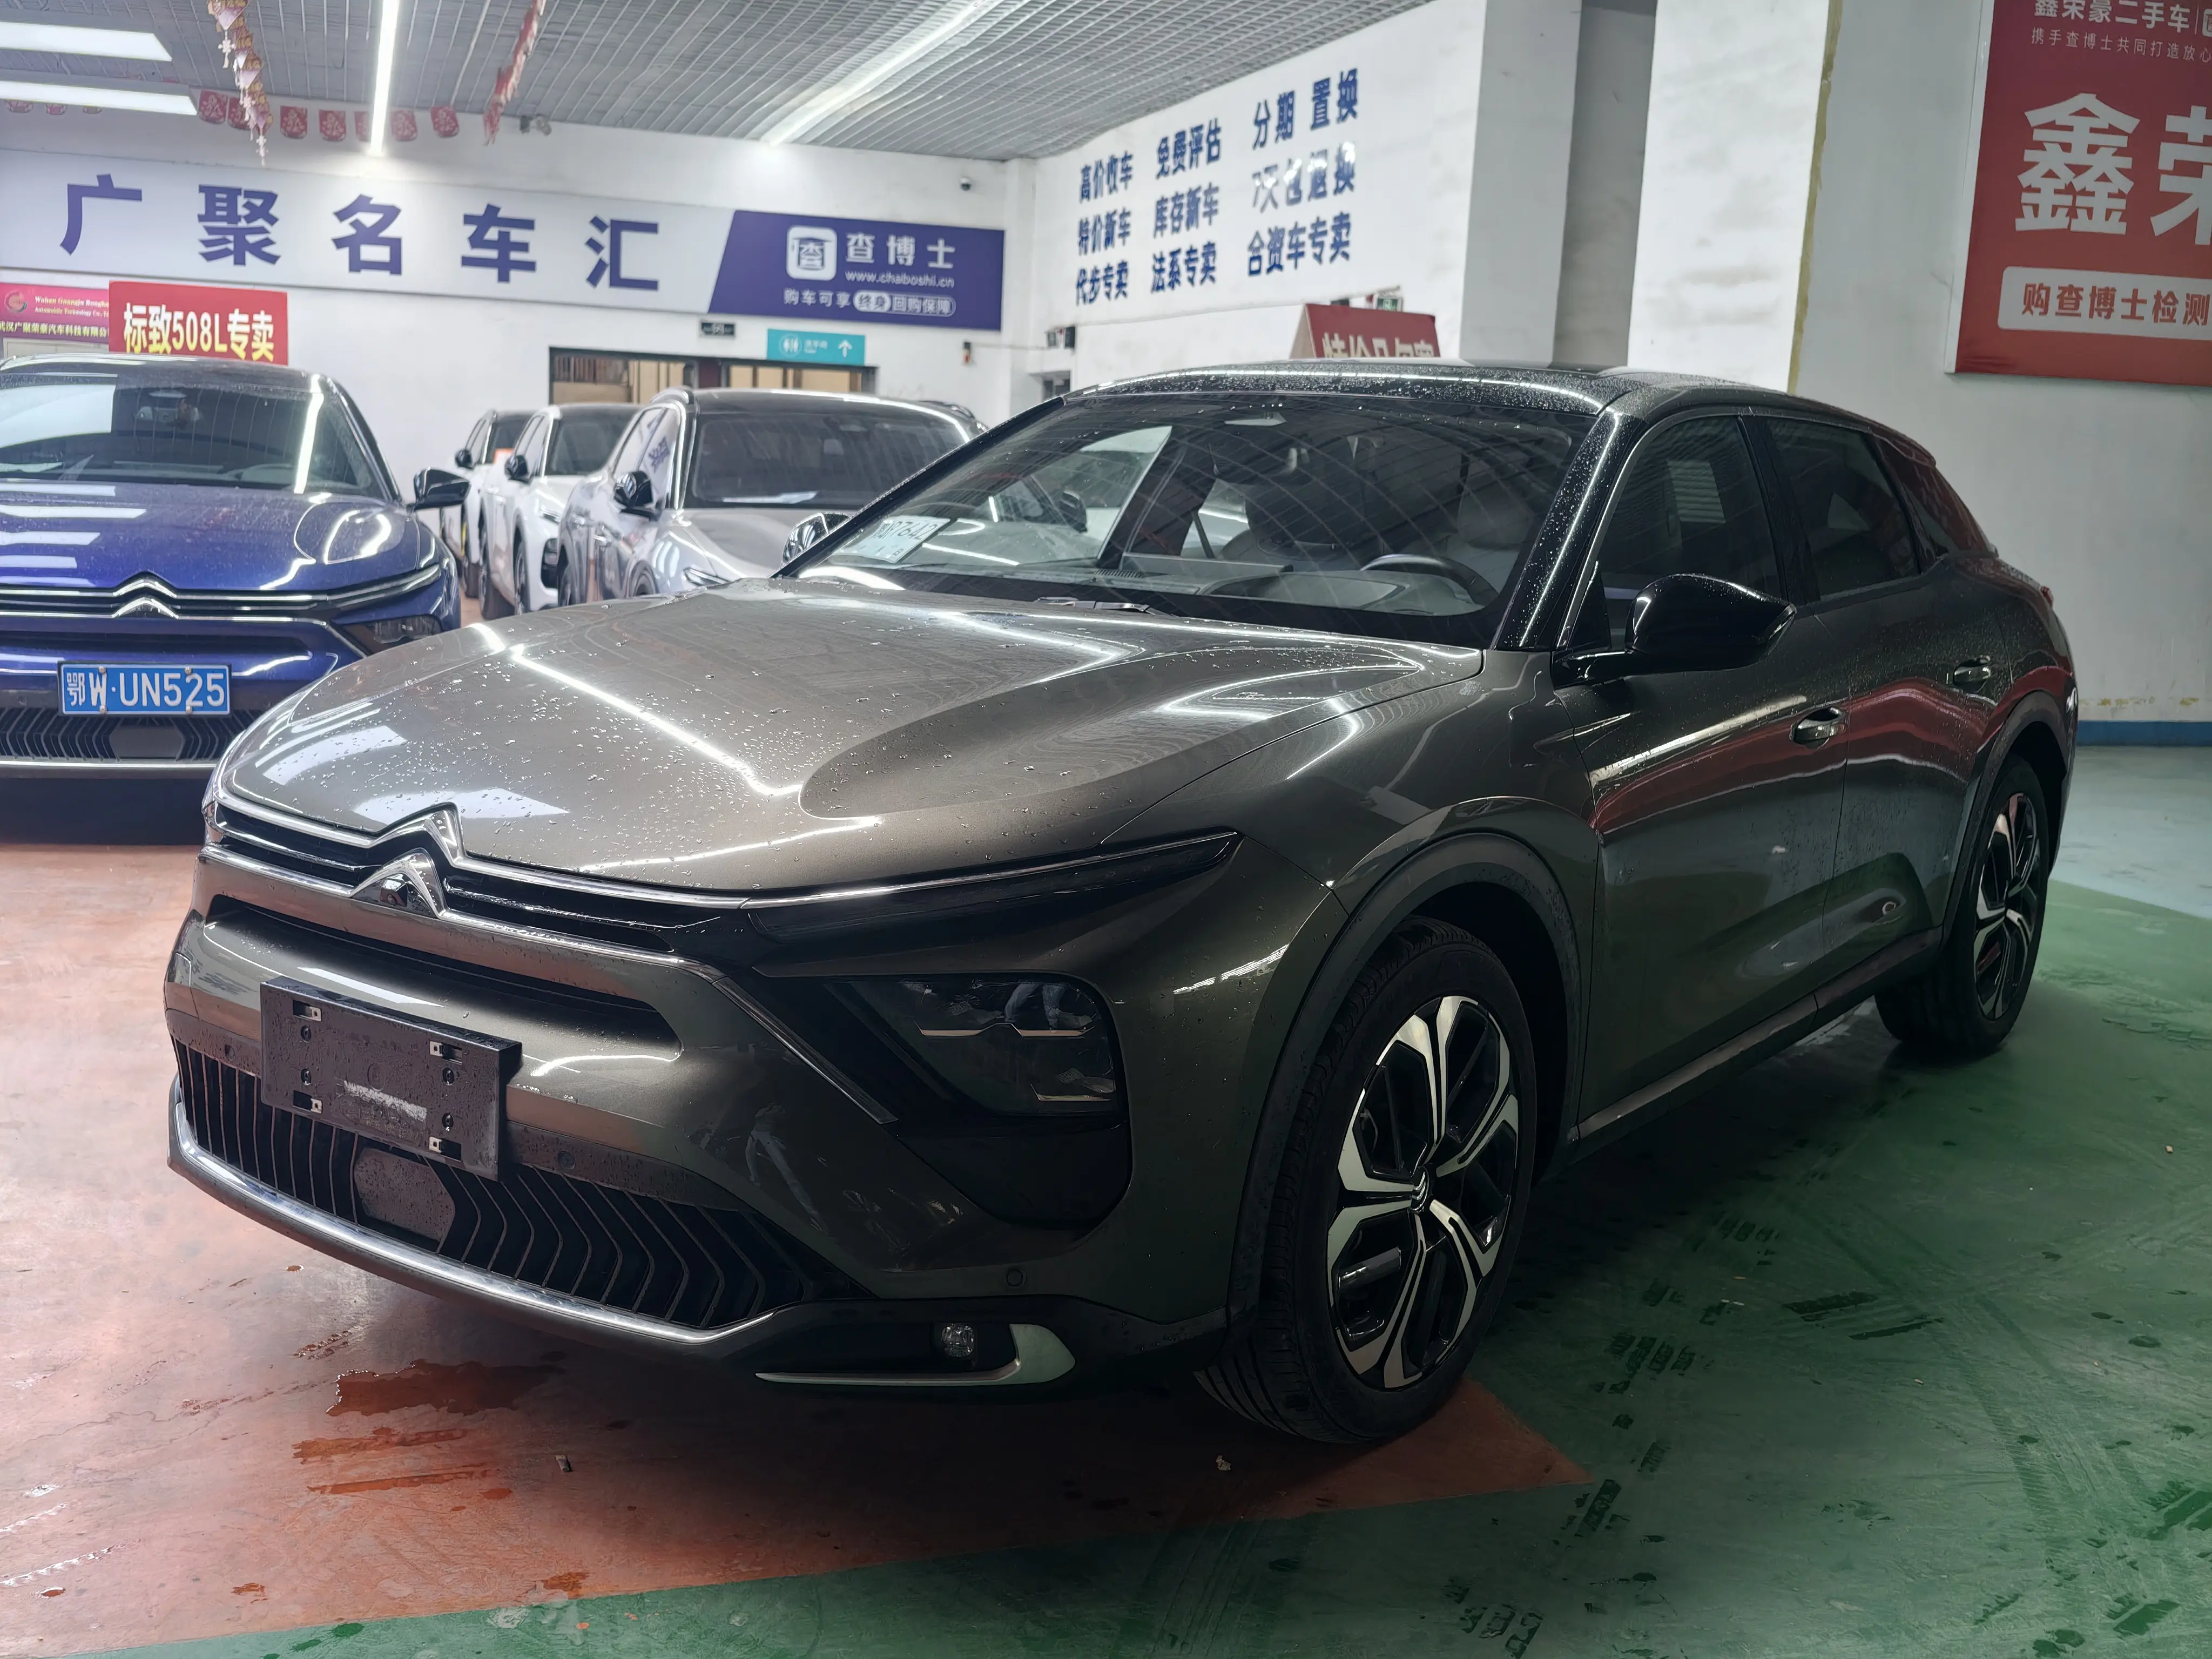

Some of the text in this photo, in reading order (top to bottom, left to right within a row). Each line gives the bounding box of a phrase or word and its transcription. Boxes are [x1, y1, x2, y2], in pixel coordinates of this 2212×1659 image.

[2031, 26, 2211, 63] 携手查博士共同打造放心
[1080, 68, 1357, 204] 高价收车 免费评估 分期 置换
[59, 173, 659, 292] 广聚名车汇
[1077, 207, 1131, 257] 特价新车
[1154, 182, 1219, 239] 库存新车
[846, 232, 955, 269] 查博士
[1076, 211, 1351, 307] 代步专卖 法系专卖 合资车专卖
[783, 287, 851, 308] 购车可享
[2021, 282, 2211, 327] 购查博士检测
[124, 302, 274, 363] 标致508L专卖
